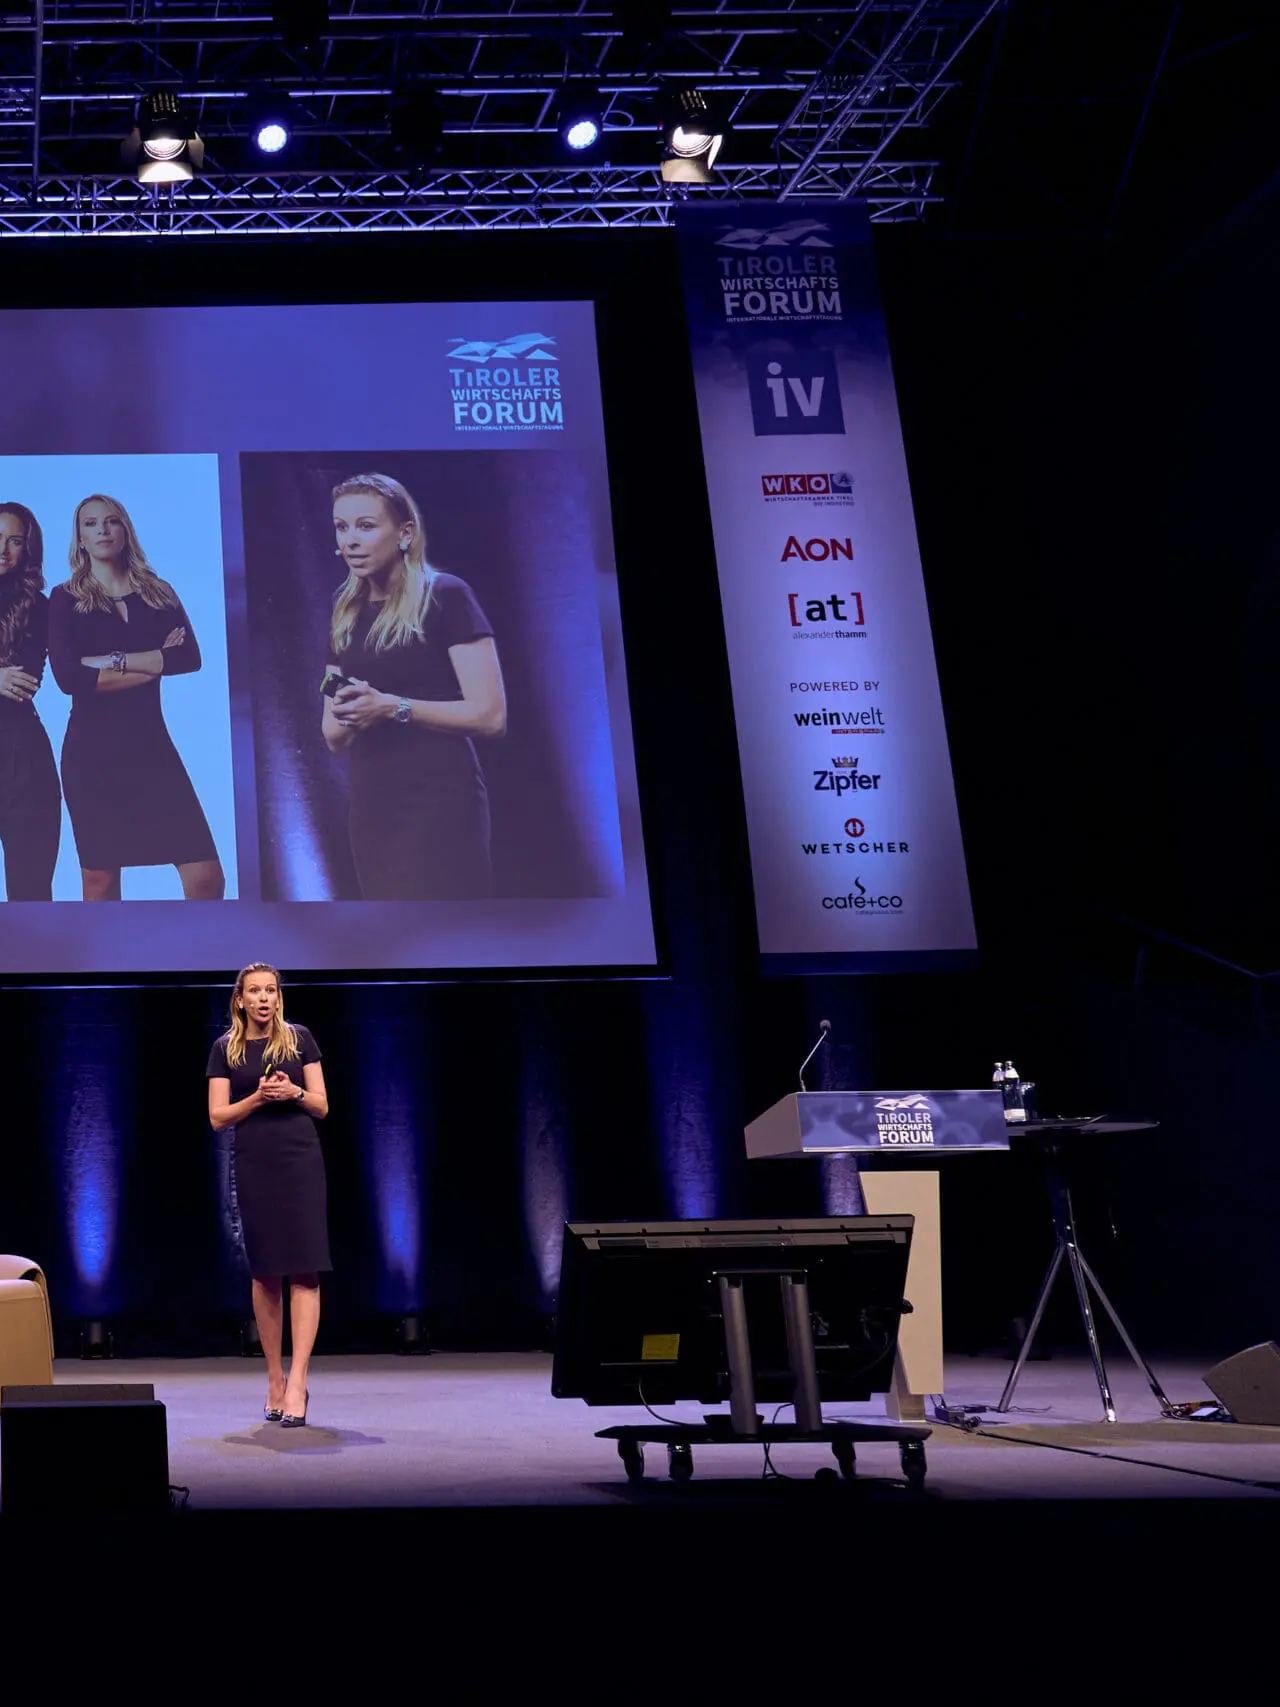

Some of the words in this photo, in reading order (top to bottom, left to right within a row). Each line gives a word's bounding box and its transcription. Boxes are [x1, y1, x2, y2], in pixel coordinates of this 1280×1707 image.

[721, 276, 839, 290] WIRTSCHAFTS
[724, 291, 841, 315] FORUM
[451, 388, 561, 400] WIRTSCHAFTS
[767, 362, 824, 417] iv
[453, 401, 564, 424] FORUM
[763, 476, 827, 492] WKO
[781, 536, 853, 561] AON
[790, 681, 859, 692] POWERED
[864, 681, 880, 691] BY
[794, 706, 885, 727] weinwelt
[813, 770, 881, 796] Zipfer
[802, 842, 910, 854] WETSCHER
[877, 1123, 933, 1131] WIRTSCHAFTS
[879, 1131, 934, 1143] FORUM
